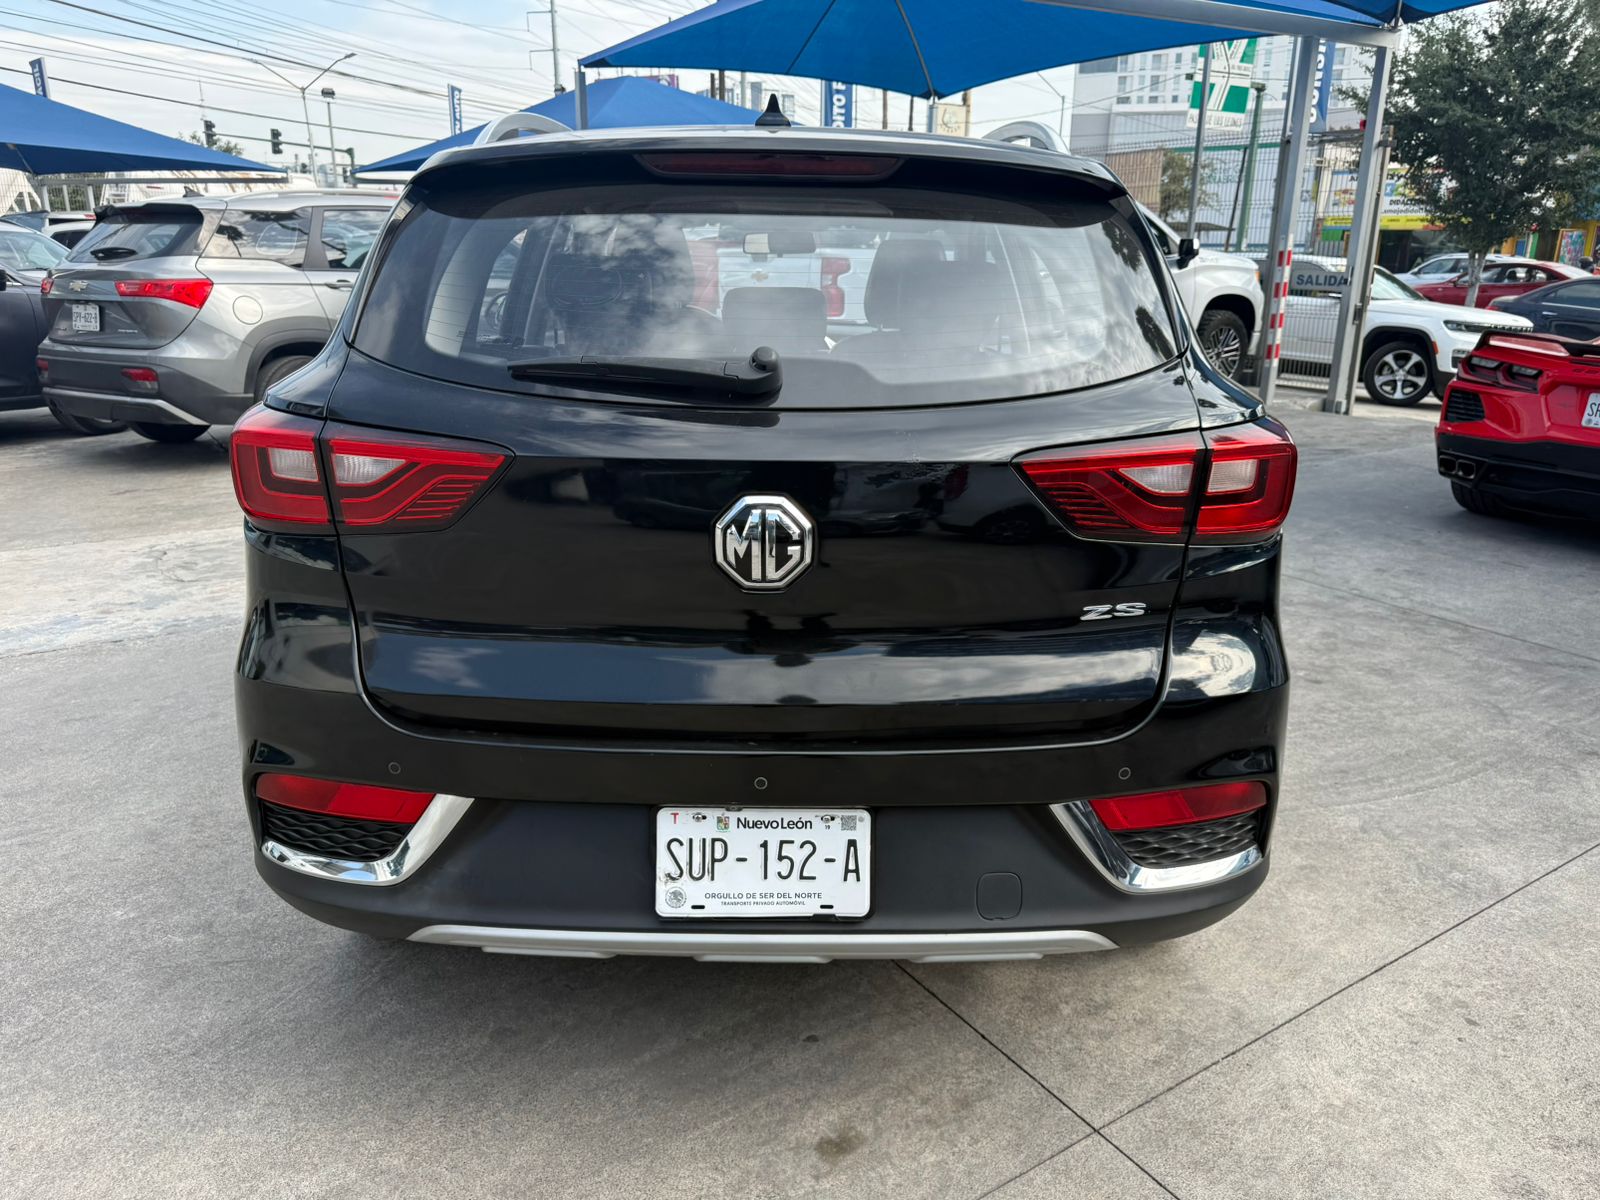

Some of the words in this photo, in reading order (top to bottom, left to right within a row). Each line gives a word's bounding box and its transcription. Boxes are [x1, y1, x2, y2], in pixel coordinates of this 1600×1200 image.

[1296, 274, 1346, 287] SALIDA
[726, 508, 802, 582] MG
[1080, 602, 1147, 621] ZS
[666, 837, 861, 883] SUP-152-A
